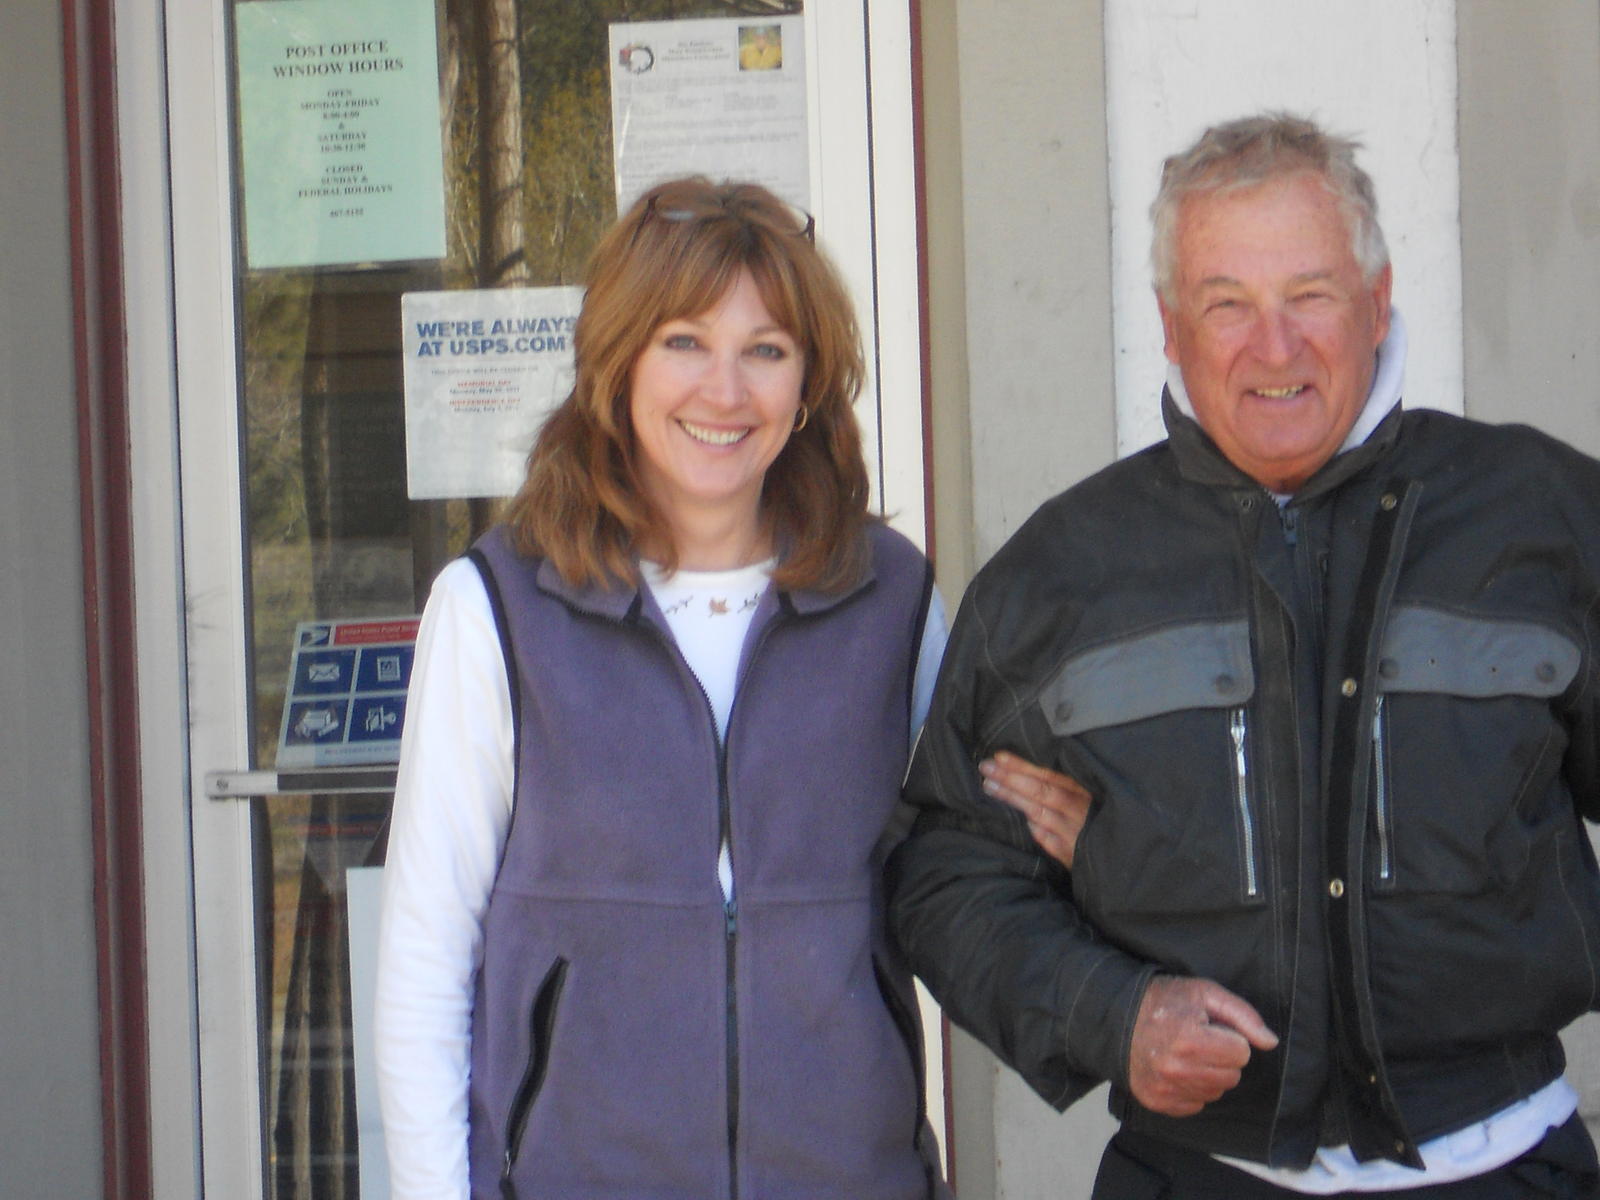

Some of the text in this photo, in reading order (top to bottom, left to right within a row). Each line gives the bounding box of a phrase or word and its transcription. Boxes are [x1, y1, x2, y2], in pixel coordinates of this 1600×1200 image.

[286, 40, 388, 59] POST OFFICE
[273, 58, 403, 78] WINDOW HOURS
[327, 88, 352, 97] OPEN
[319, 132, 367, 142] SATURDAY
[325, 164, 364, 174] CLOSED
[321, 175, 358, 185] SUNDAY
[298, 184, 393, 198] FEDERAL HOLIDAYS
[416, 316, 577, 338] WE'RE ALWAYS
[417, 336, 566, 357] AT USPS.COM
